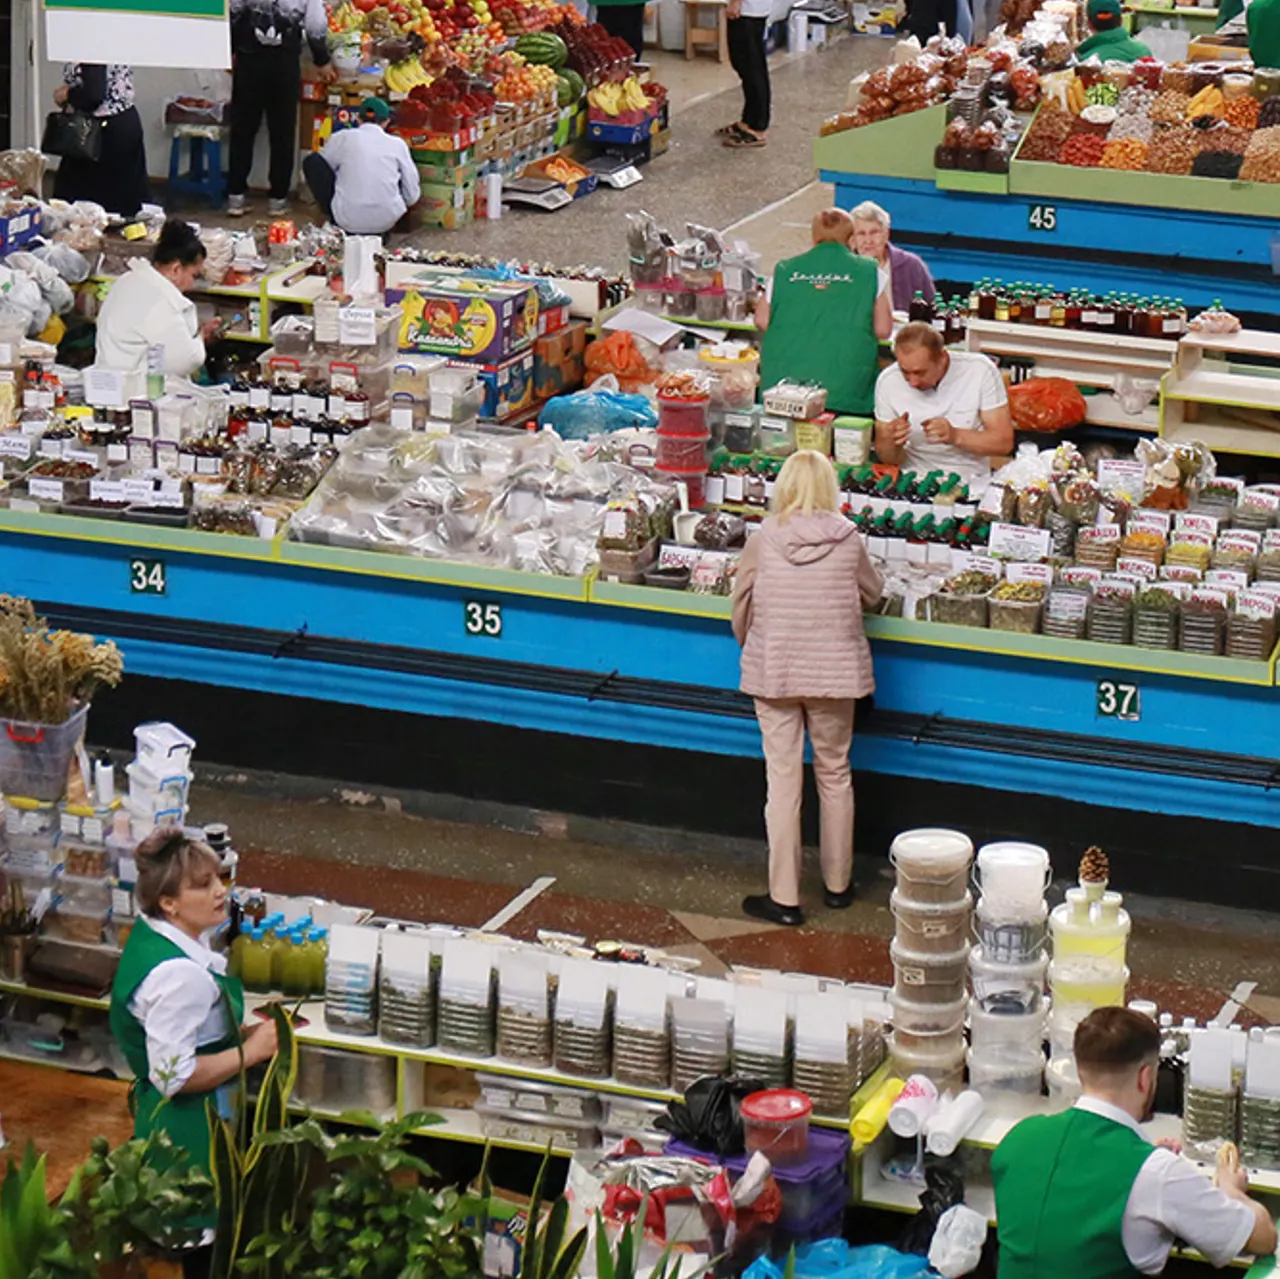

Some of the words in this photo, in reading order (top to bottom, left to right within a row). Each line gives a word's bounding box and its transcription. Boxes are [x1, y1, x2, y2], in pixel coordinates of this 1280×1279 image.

[1029, 206, 1056, 229] 45
[132, 561, 166, 593] 34
[466, 602, 502, 635] 35
[1099, 681, 1136, 714] 37
